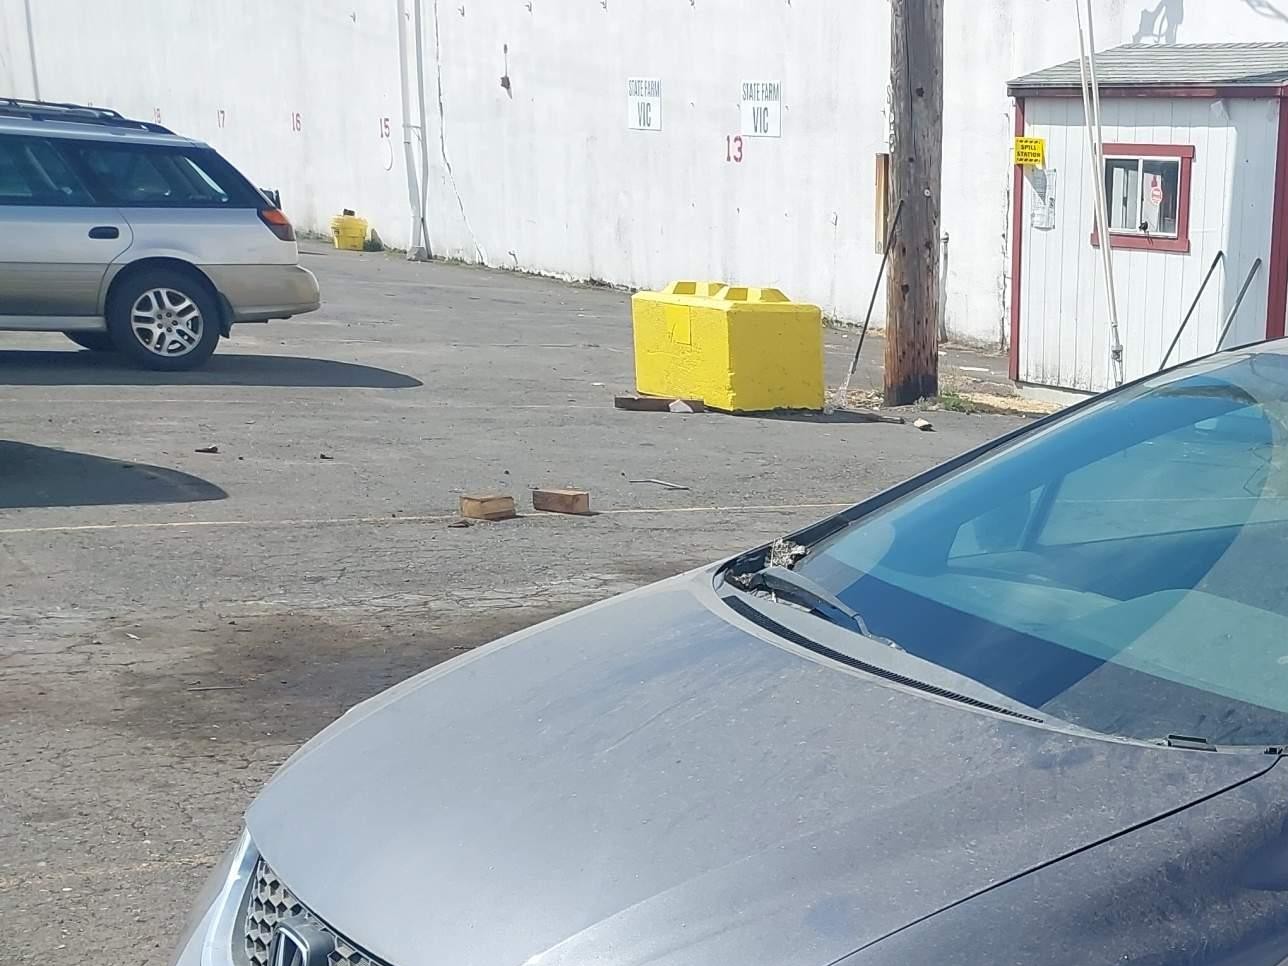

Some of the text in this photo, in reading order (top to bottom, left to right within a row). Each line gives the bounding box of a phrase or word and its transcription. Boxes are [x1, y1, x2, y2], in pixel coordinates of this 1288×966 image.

[628, 79, 660, 98] STATE FARM
[742, 82, 779, 102] STATE FARM
[217, 109, 226, 129] 17
[291, 111, 302, 132] 16
[637, 102, 652, 128] VIC
[752, 106, 769, 134] VIC
[379, 117, 391, 138] 15
[725, 135, 744, 163] 13
